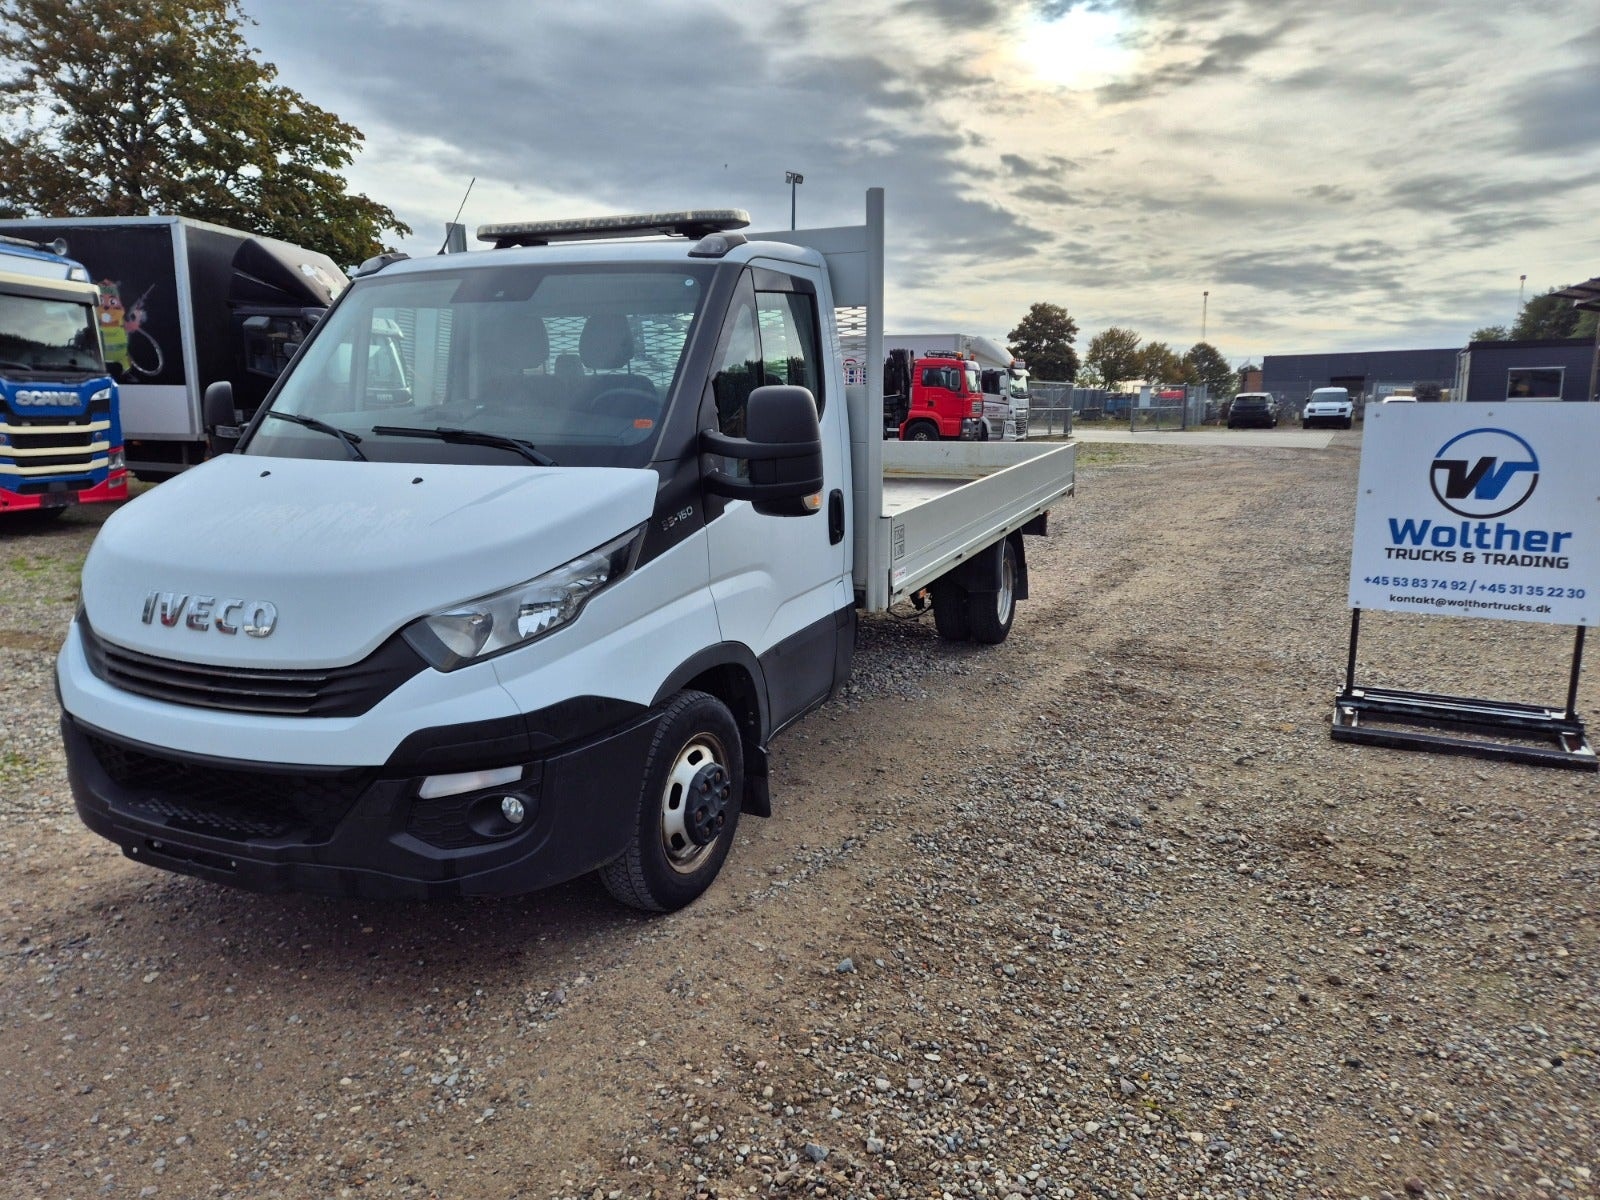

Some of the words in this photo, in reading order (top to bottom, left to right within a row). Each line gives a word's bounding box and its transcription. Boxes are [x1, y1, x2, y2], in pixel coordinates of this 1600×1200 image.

[15, 390, 82, 406] SCANIA
[1388, 518, 1572, 553] Wolther
[1385, 548, 1457, 562] TRUCKS
[1462, 552, 1476, 564] &
[1482, 553, 1569, 569] TRADING
[1364, 576, 1389, 586] +45
[1392, 577, 1409, 587] 53
[1411, 578, 1428, 588] 83
[1431, 580, 1448, 590] 74
[1450, 581, 1467, 591] 92
[1468, 580, 1477, 594] /
[1479, 584, 1506, 594] +45
[1509, 585, 1523, 595] 31
[1526, 586, 1544, 596] 35
[1547, 587, 1564, 598] 22
[1566, 588, 1586, 599] 30
[141, 591, 279, 638] IVECO
[1389, 594, 1552, 613] kontakt@wolthertrucks.dk
